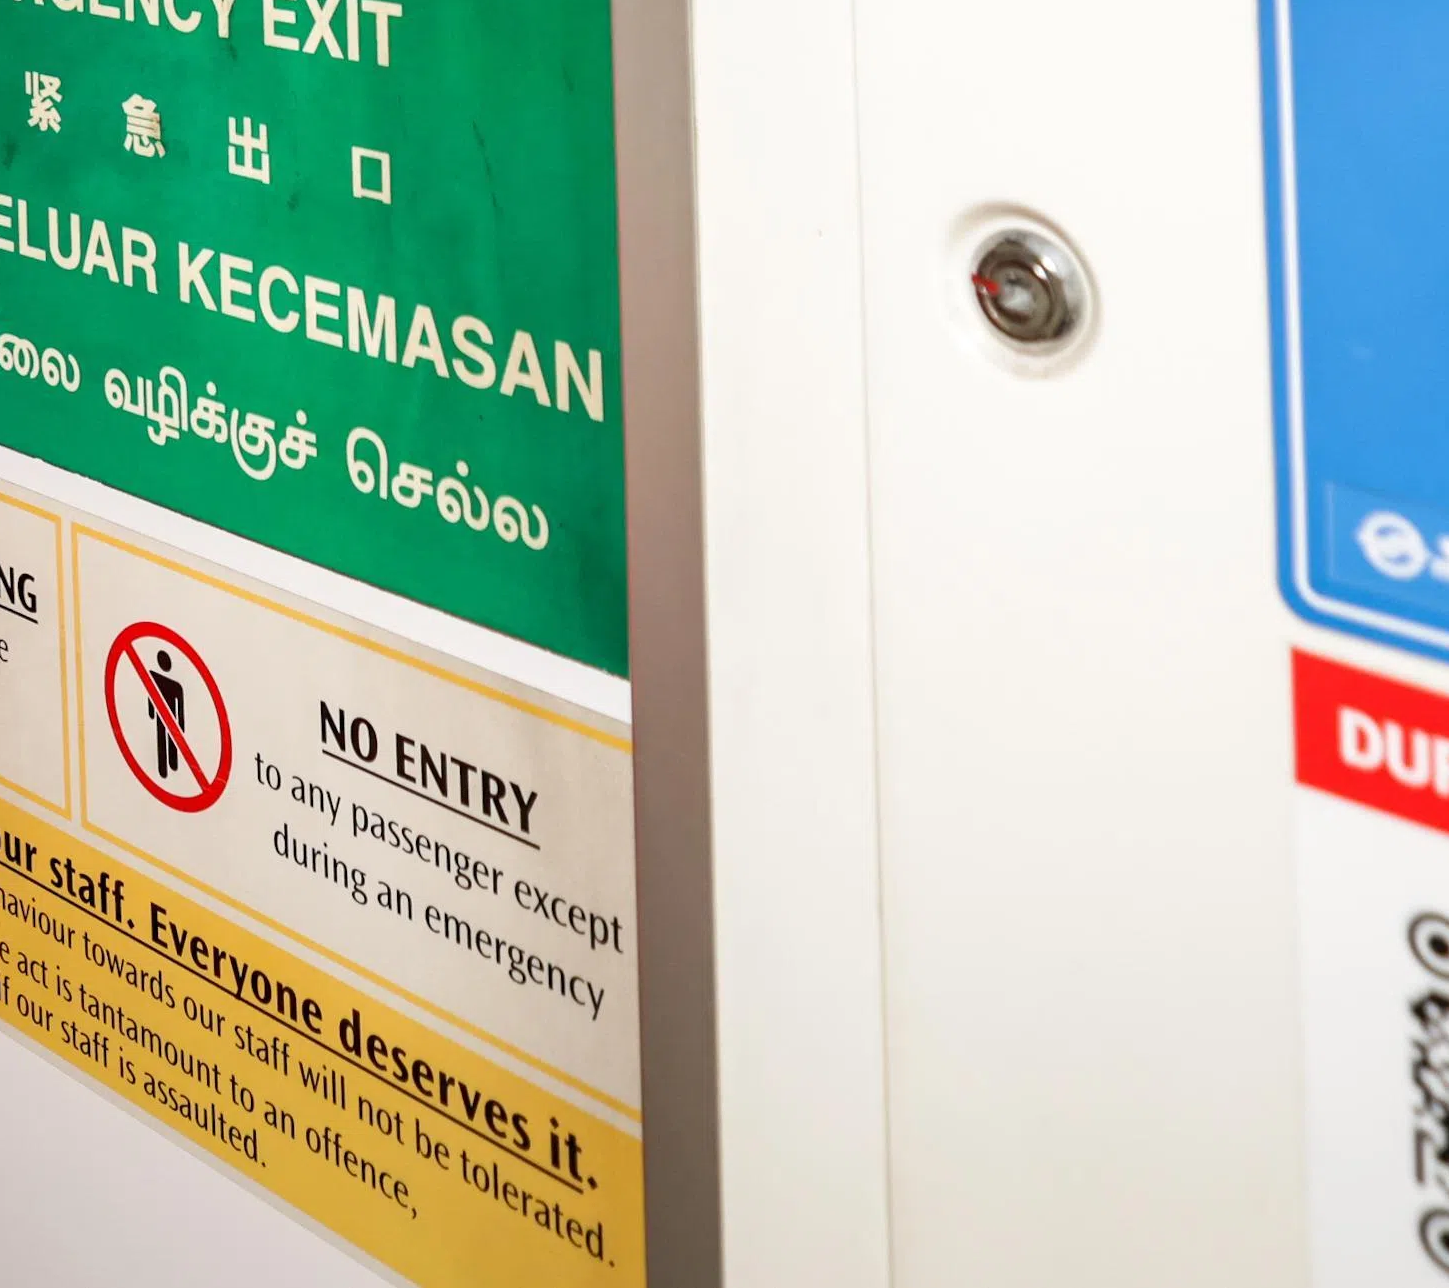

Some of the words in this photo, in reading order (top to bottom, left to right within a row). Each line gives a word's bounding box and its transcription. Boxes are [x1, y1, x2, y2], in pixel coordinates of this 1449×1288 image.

[179, 242, 603, 421] KECEMASAN
[346, 427, 549, 550] செல்ல
[255, 753, 281, 790] to
[292, 776, 340, 826] any
[353, 804, 503, 894] passenger
[515, 881, 623, 953] except
[321, 701, 377, 762] NO
[396, 734, 537, 833] ENTRY
[274, 823, 367, 905] during
[378, 882, 412, 920] an
[425, 906, 604, 1021] emergency
[17, 994, 53, 1032] our
[61, 1019, 109, 1067] staff
[119, 1047, 136, 1085] is
[143, 1072, 266, 1167] assaulted.
[17, 950, 48, 989] act
[56, 966, 72, 1002] is
[80, 983, 221, 1095] tantamount
[230, 1074, 254, 1113] to
[264, 1101, 295, 1140] an
[306, 1126, 418, 1219] offence,
[50, 856, 135, 929] staff.
[150, 902, 323, 1035] Everyone
[339, 1009, 531, 1151] deserves
[549, 1117, 598, 1190] it.
[84, 932, 175, 1009] towards
[184, 996, 225, 1037] our
[235, 1024, 289, 1076] staff
[299, 1060, 346, 1110] will
[358, 1095, 404, 1145] not
[415, 1119, 450, 1170] be
[460, 1150, 615, 1267] tolerated.
